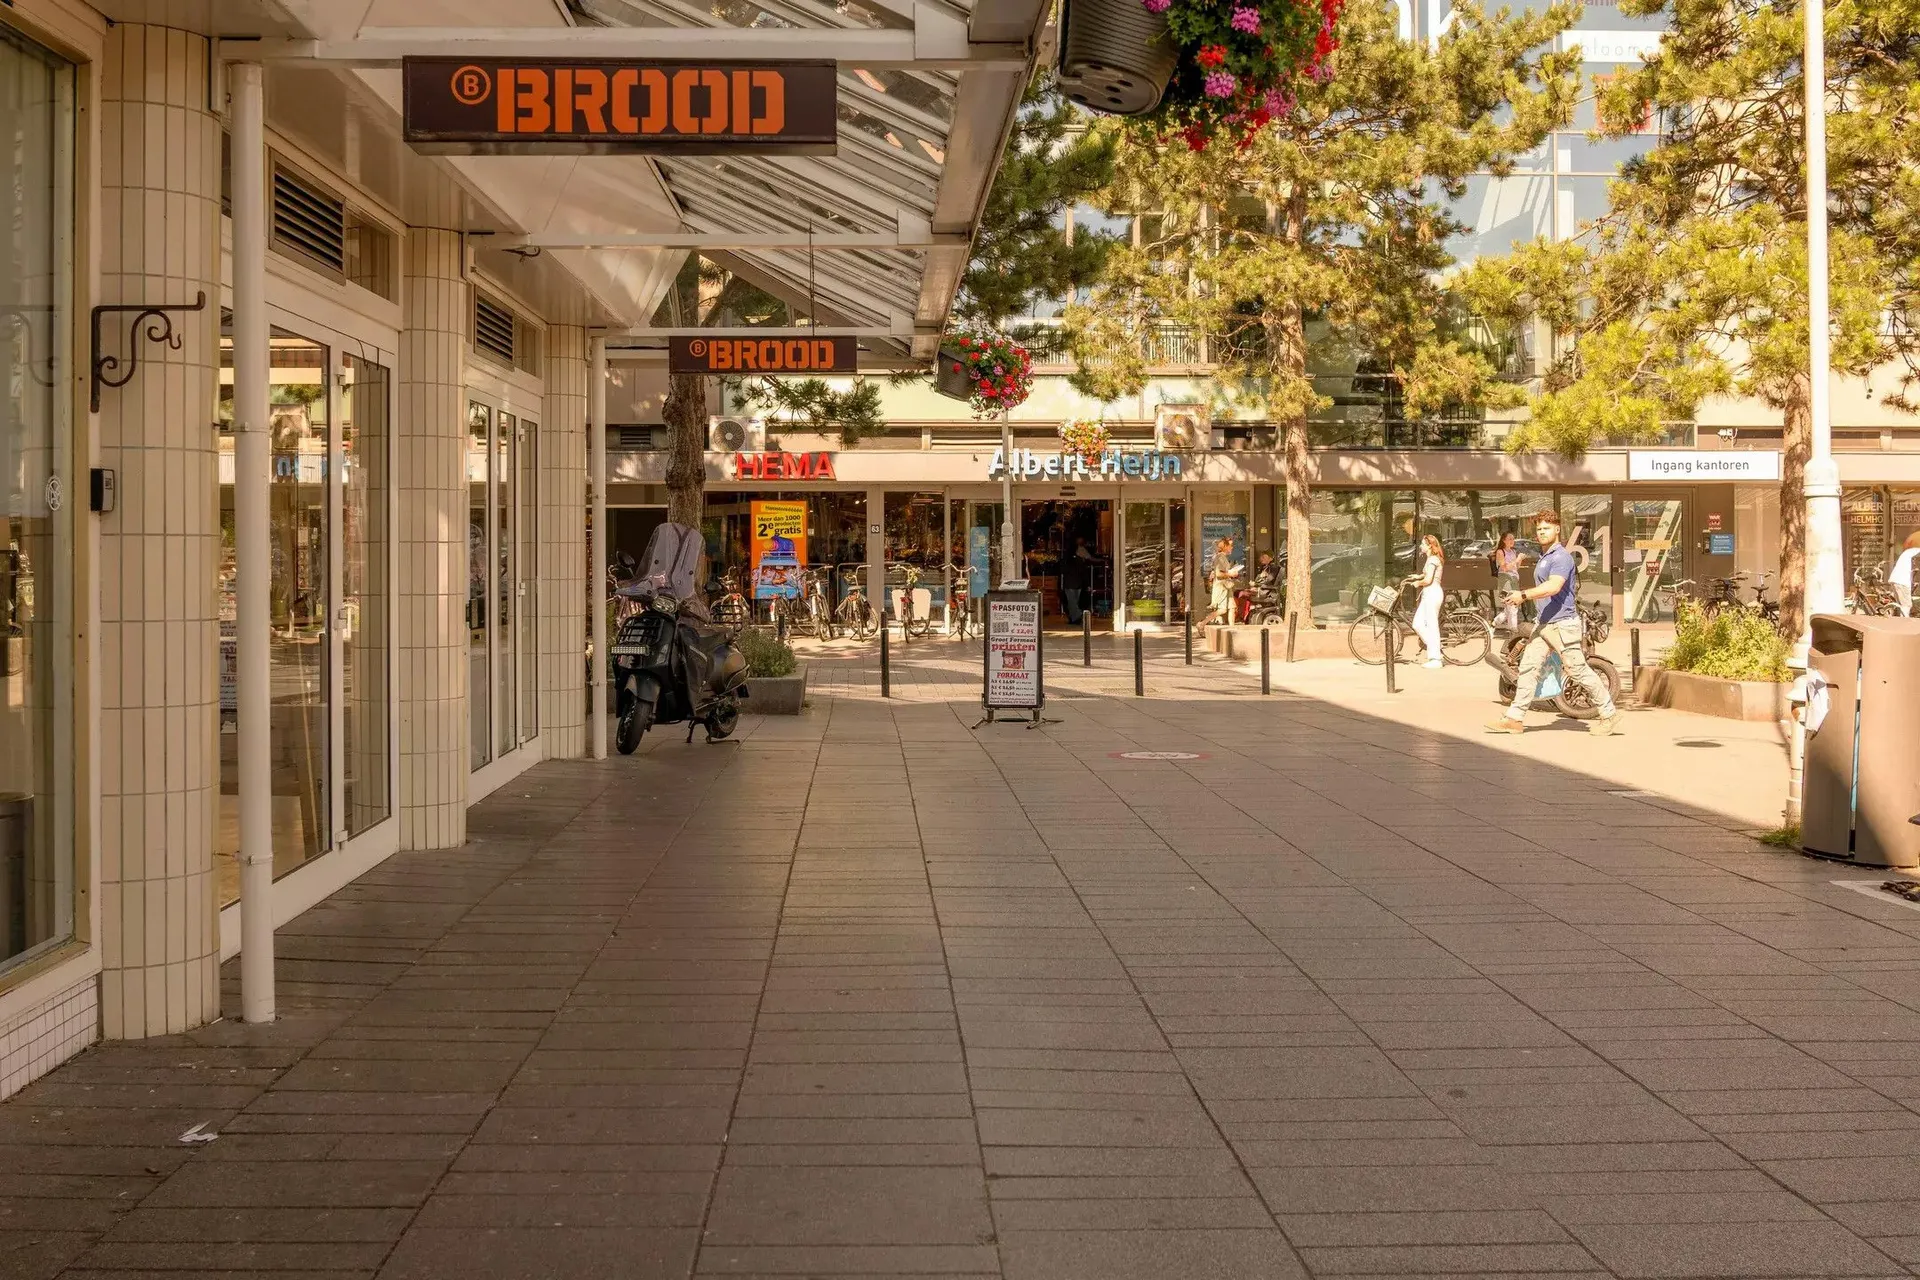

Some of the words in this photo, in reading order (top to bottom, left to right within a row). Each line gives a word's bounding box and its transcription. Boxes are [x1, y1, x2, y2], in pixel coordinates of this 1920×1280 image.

[497, 68, 785, 134] BROOD
[709, 340, 834, 369] BROOD
[736, 451, 836, 480] HEMA
[989, 447, 1088, 475] Albert
[1100, 448, 1181, 480] Heijn
[1651, 459, 1692, 474] Ingang
[1696, 459, 1750, 471] kantoren
[774, 524, 802, 537] gratis
[1565, 525, 1610, 573] 61
[991, 642, 1036, 652] printen
